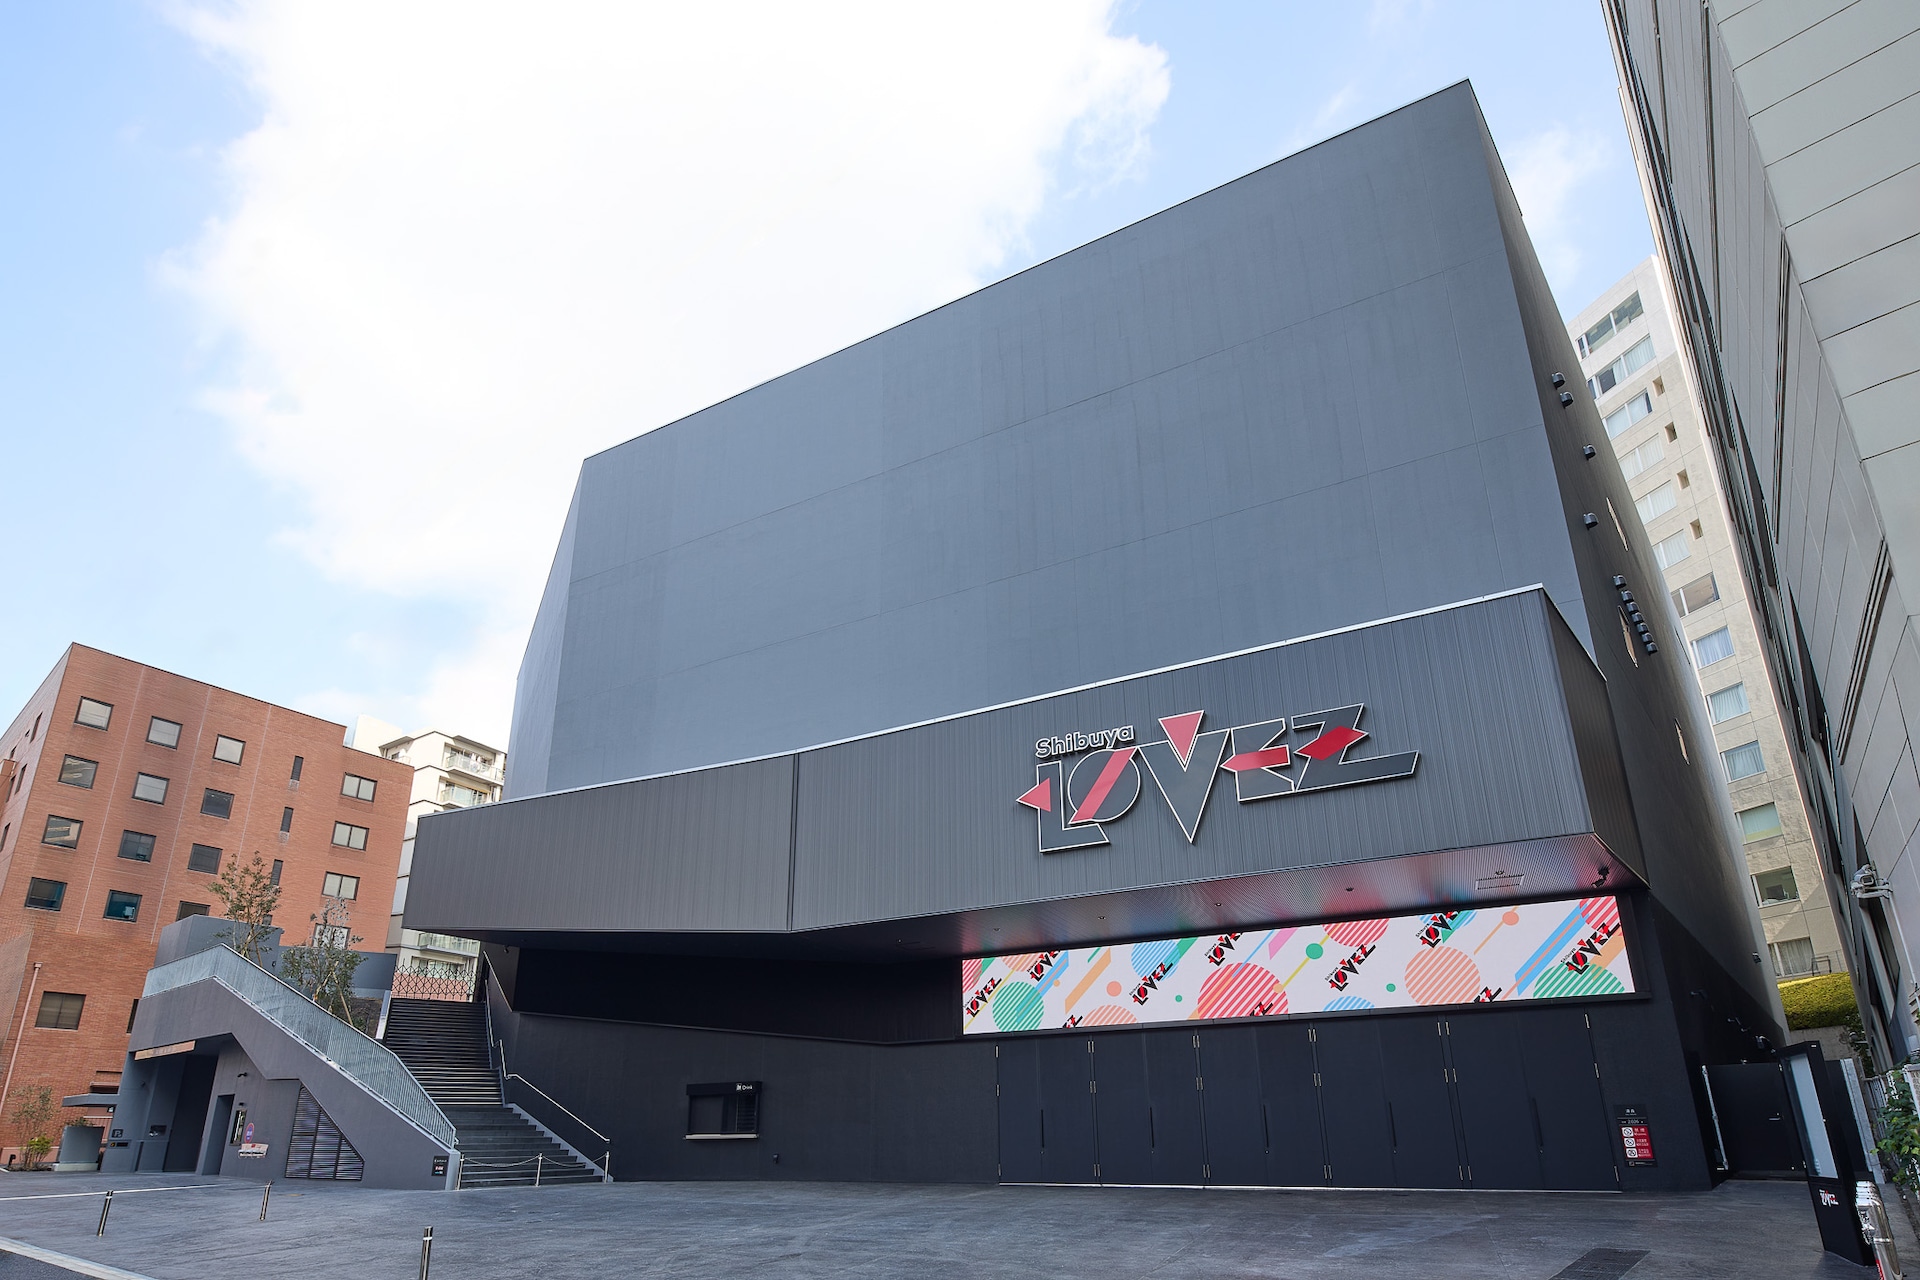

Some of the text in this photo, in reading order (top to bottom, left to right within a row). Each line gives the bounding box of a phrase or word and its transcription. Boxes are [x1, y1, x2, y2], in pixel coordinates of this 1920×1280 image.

[1035, 725, 1135, 758] Shibuya
[1016, 703, 1420, 853] LOVEZ
[1328, 944, 1376, 992] LOVEZ
[1566, 922, 1621, 975] LOVEZ
[965, 977, 1002, 1017] LOVEZ
[1132, 962, 1173, 1006] LOVEZ
